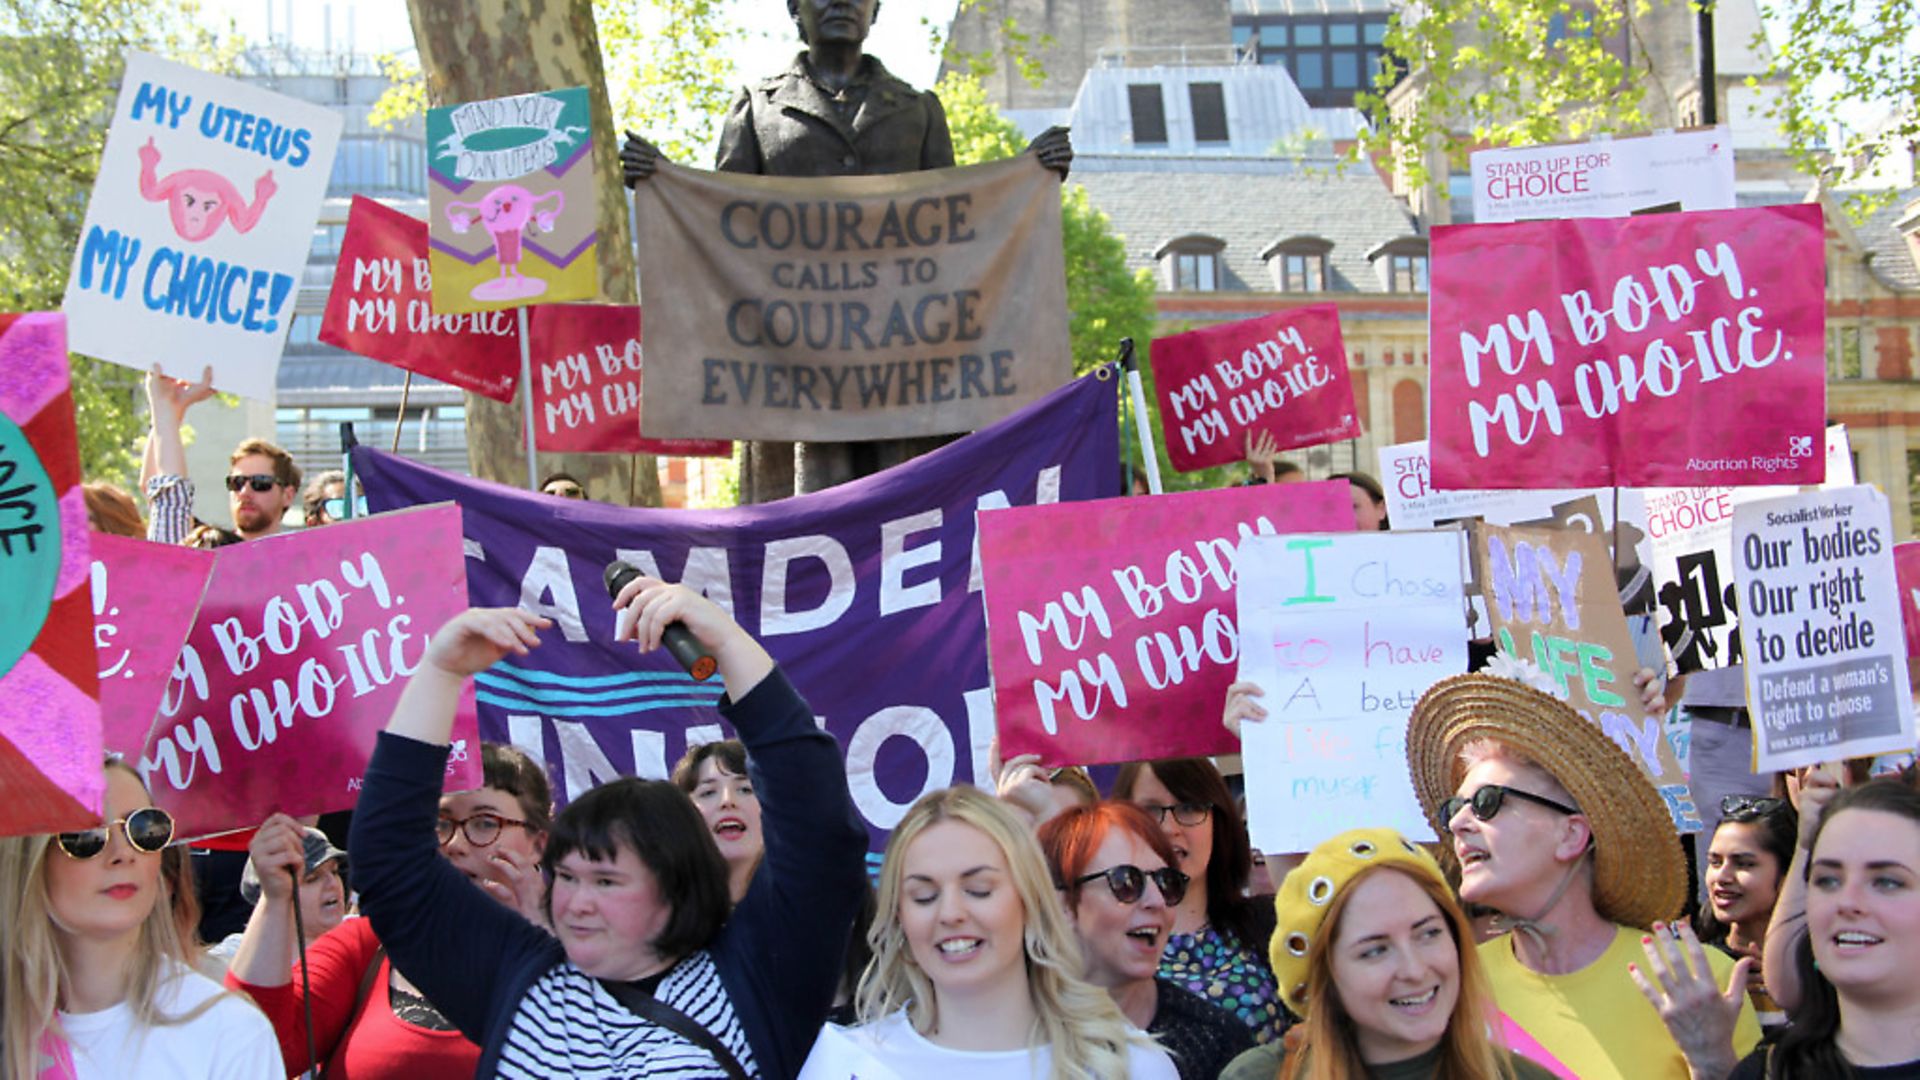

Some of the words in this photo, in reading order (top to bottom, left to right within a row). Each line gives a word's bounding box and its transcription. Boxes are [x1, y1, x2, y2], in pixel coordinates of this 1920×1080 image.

[131, 82, 192, 130] MY
[200, 101, 312, 168] UTERUS
[454, 100, 505, 138] MIND
[515, 95, 554, 127] YOUR
[461, 151, 497, 179] OWN
[1486, 159, 1542, 179] STAND
[1546, 157, 1571, 174] UP
[1575, 152, 1611, 171] FOR
[1487, 170, 1591, 200] CHOICE
[720, 193, 977, 252] COURAGE
[79, 225, 142, 300] MY
[143, 247, 295, 334] CHOICE!
[352, 257, 402, 294] MY
[773, 260, 879, 291] CALLS
[896, 257, 938, 287] TO
[347, 297, 397, 334] MY
[727, 290, 982, 351] COURAGE
[1460, 309, 1554, 388] MY
[1560, 242, 1759, 347] BODY.
[541, 352, 592, 396] MY
[595, 338, 642, 376] BO
[702, 350, 1017, 411] EVERYWHERE
[1169, 373, 1218, 420] MY
[1215, 326, 1313, 390] BODY.
[1468, 379, 1563, 458] MY
[1573, 307, 1793, 419] CHOICE.
[544, 391, 596, 434] MY
[1180, 408, 1230, 455] MY
[1229, 355, 1336, 426] CHOICE.
[1394, 455, 1428, 475] STA
[1686, 457, 1748, 471] Abortion
[1752, 455, 1799, 473] Rights
[1648, 493, 1735, 539] CHOICE
[463, 464, 1061, 645] AMDE
[1744, 532, 1793, 571] Our
[1802, 520, 1882, 565] bodies
[1017, 585, 1113, 666] MY
[1112, 516, 1276, 619] BOD
[1282, 539, 1336, 607] I
[1352, 561, 1448, 599] Chose
[1487, 535, 1583, 630] MY
[1748, 578, 1799, 617] Our
[1809, 566, 1866, 616] right
[160, 644, 210, 717] Y
[211, 552, 405, 676] BODY.
[1273, 626, 1333, 669] to
[1364, 621, 1444, 669] have
[1756, 628, 1785, 664] to
[1796, 611, 1875, 659] decide
[1033, 652, 1128, 735] MY
[1135, 608, 1240, 690] CHO
[1283, 677, 1321, 711] A
[1362, 680, 1420, 713] bett
[1762, 672, 1816, 702] Defend
[1820, 677, 1830, 694] a
[1832, 662, 1889, 691] woman's
[1764, 701, 1802, 731] right
[1806, 700, 1823, 722] to
[1828, 693, 1872, 719] choose
[136, 715, 222, 790] MY
